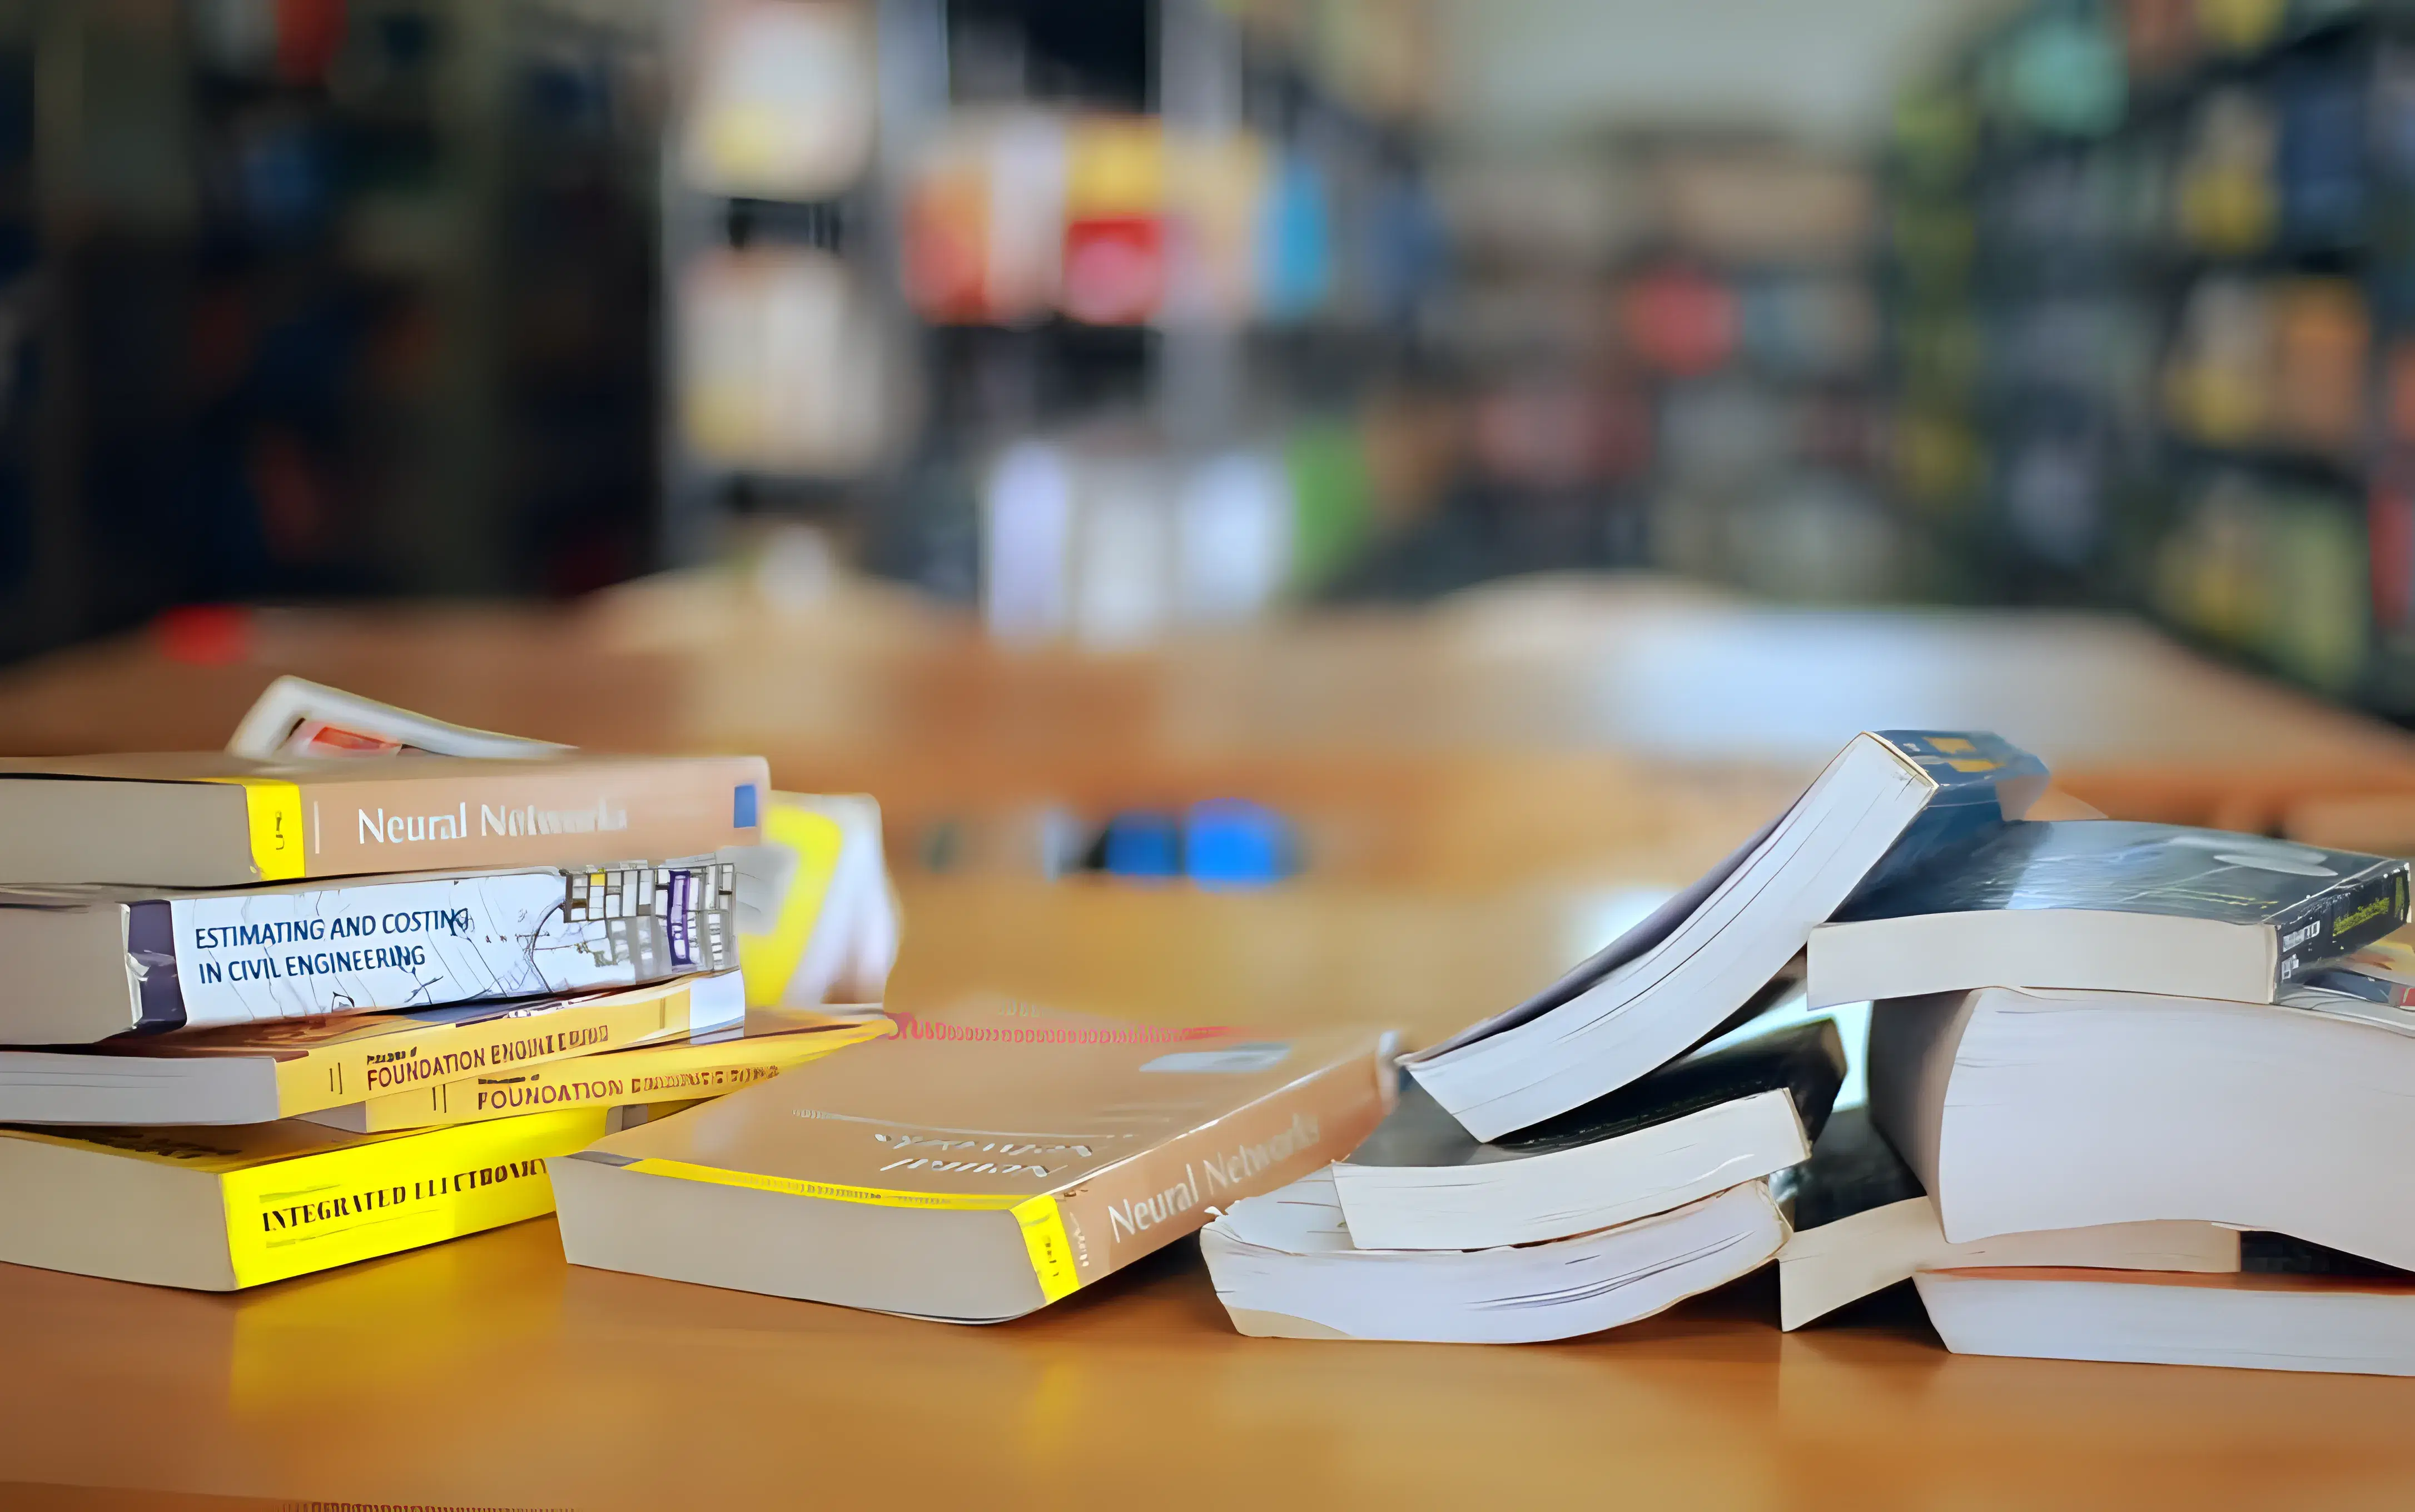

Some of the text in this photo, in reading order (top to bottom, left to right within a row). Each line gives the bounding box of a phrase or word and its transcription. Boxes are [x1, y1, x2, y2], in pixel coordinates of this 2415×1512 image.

[359, 802, 467, 844] Neural
[196, 919, 325, 949] ESTIMATING
[331, 915, 376, 940] AND
[199, 945, 425, 984] IN CIVIL ENGINEERING
[367, 1048, 485, 1091] FOUNDATION
[262, 1186, 406, 1231] INTEGRATED
[1108, 1163, 1199, 1244] Neural
